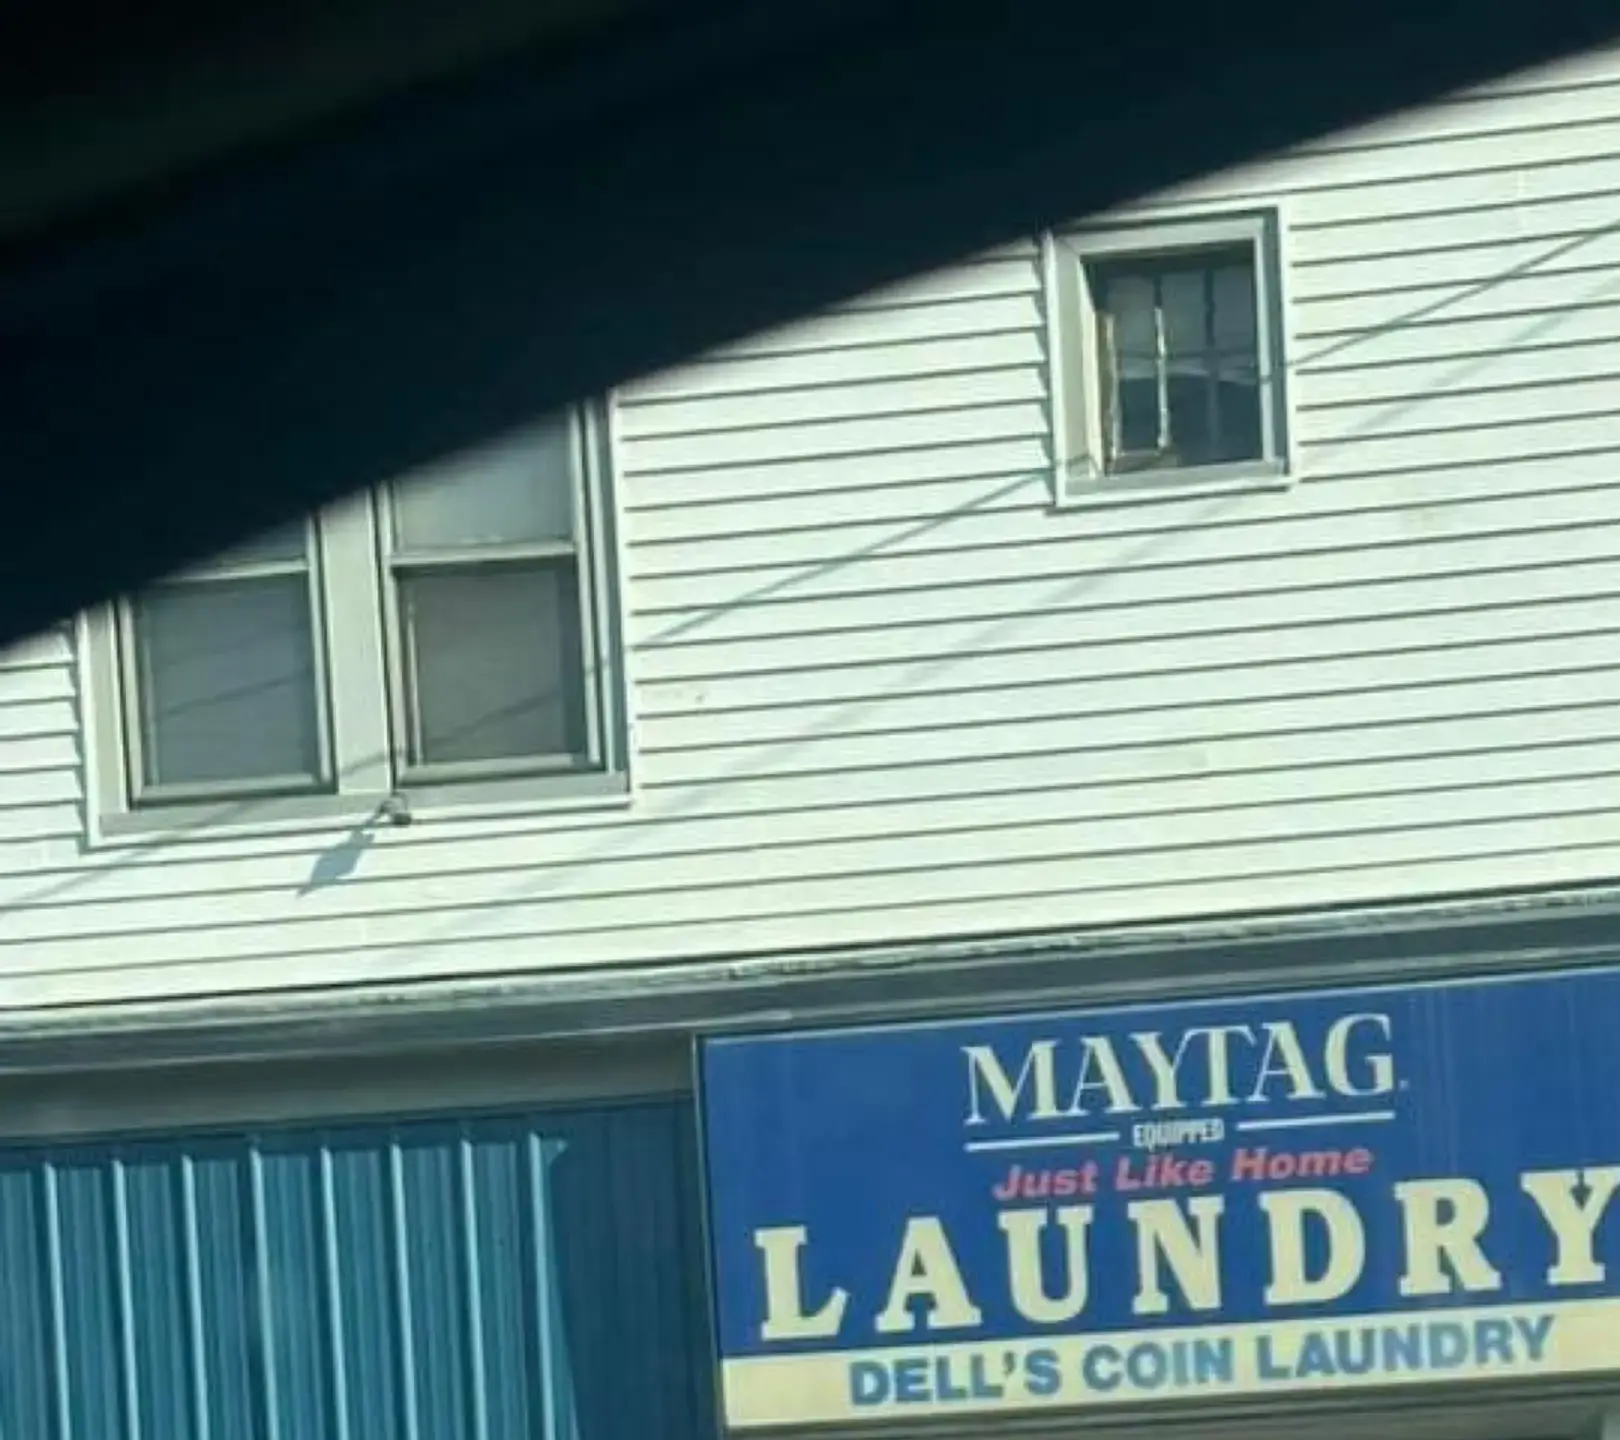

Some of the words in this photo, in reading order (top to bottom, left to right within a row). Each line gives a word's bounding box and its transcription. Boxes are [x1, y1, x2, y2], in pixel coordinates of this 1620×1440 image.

[960, 1013, 1395, 1125] MAYTAG
[1133, 1118, 1225, 1150] EQUIPPED
[993, 1160, 1098, 1199] Just
[1115, 1152, 1214, 1191] Like
[1232, 1145, 1374, 1181] Home
[849, 1344, 1062, 1407] DELL'S
[1081, 1336, 1235, 1394] COIN
[1256, 1315, 1556, 1382] LAUNDRY
